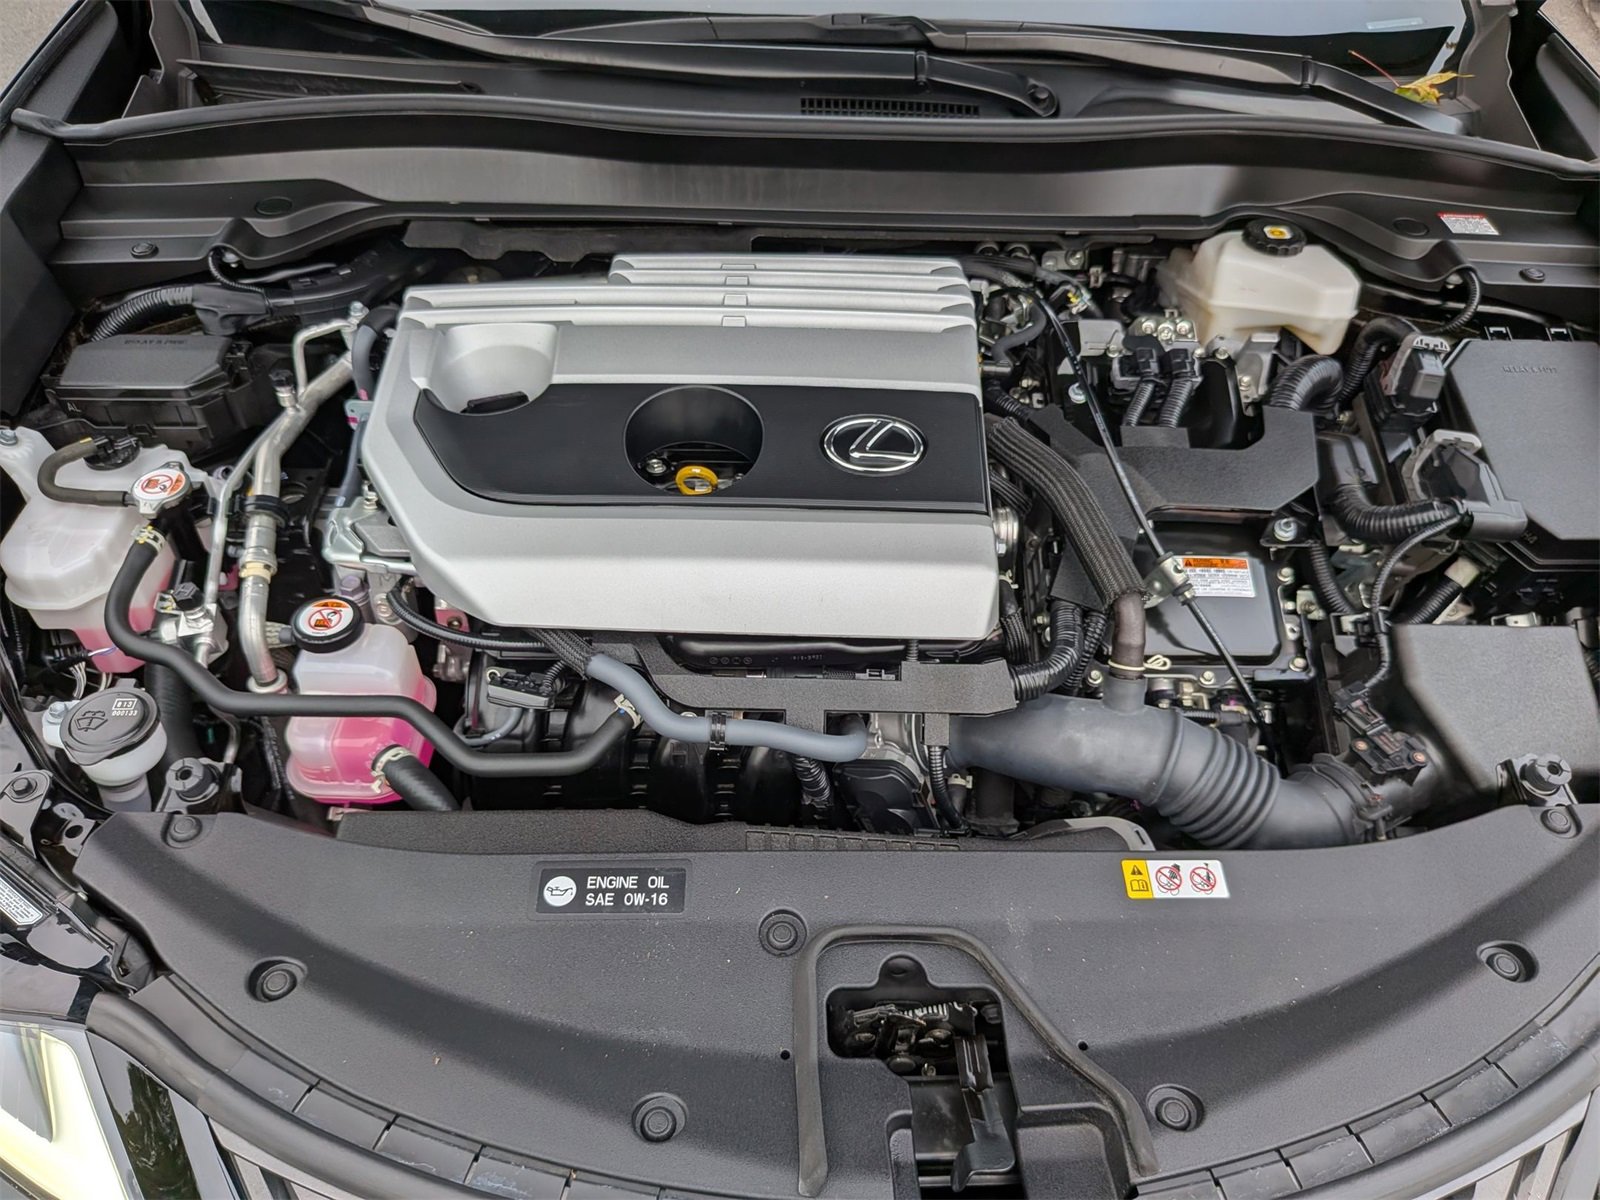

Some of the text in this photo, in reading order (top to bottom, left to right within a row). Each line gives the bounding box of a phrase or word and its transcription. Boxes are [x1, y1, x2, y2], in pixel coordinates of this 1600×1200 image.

[586, 875, 670, 889] ENGINE OIL
[585, 892, 669, 906] SAE 0W-16
